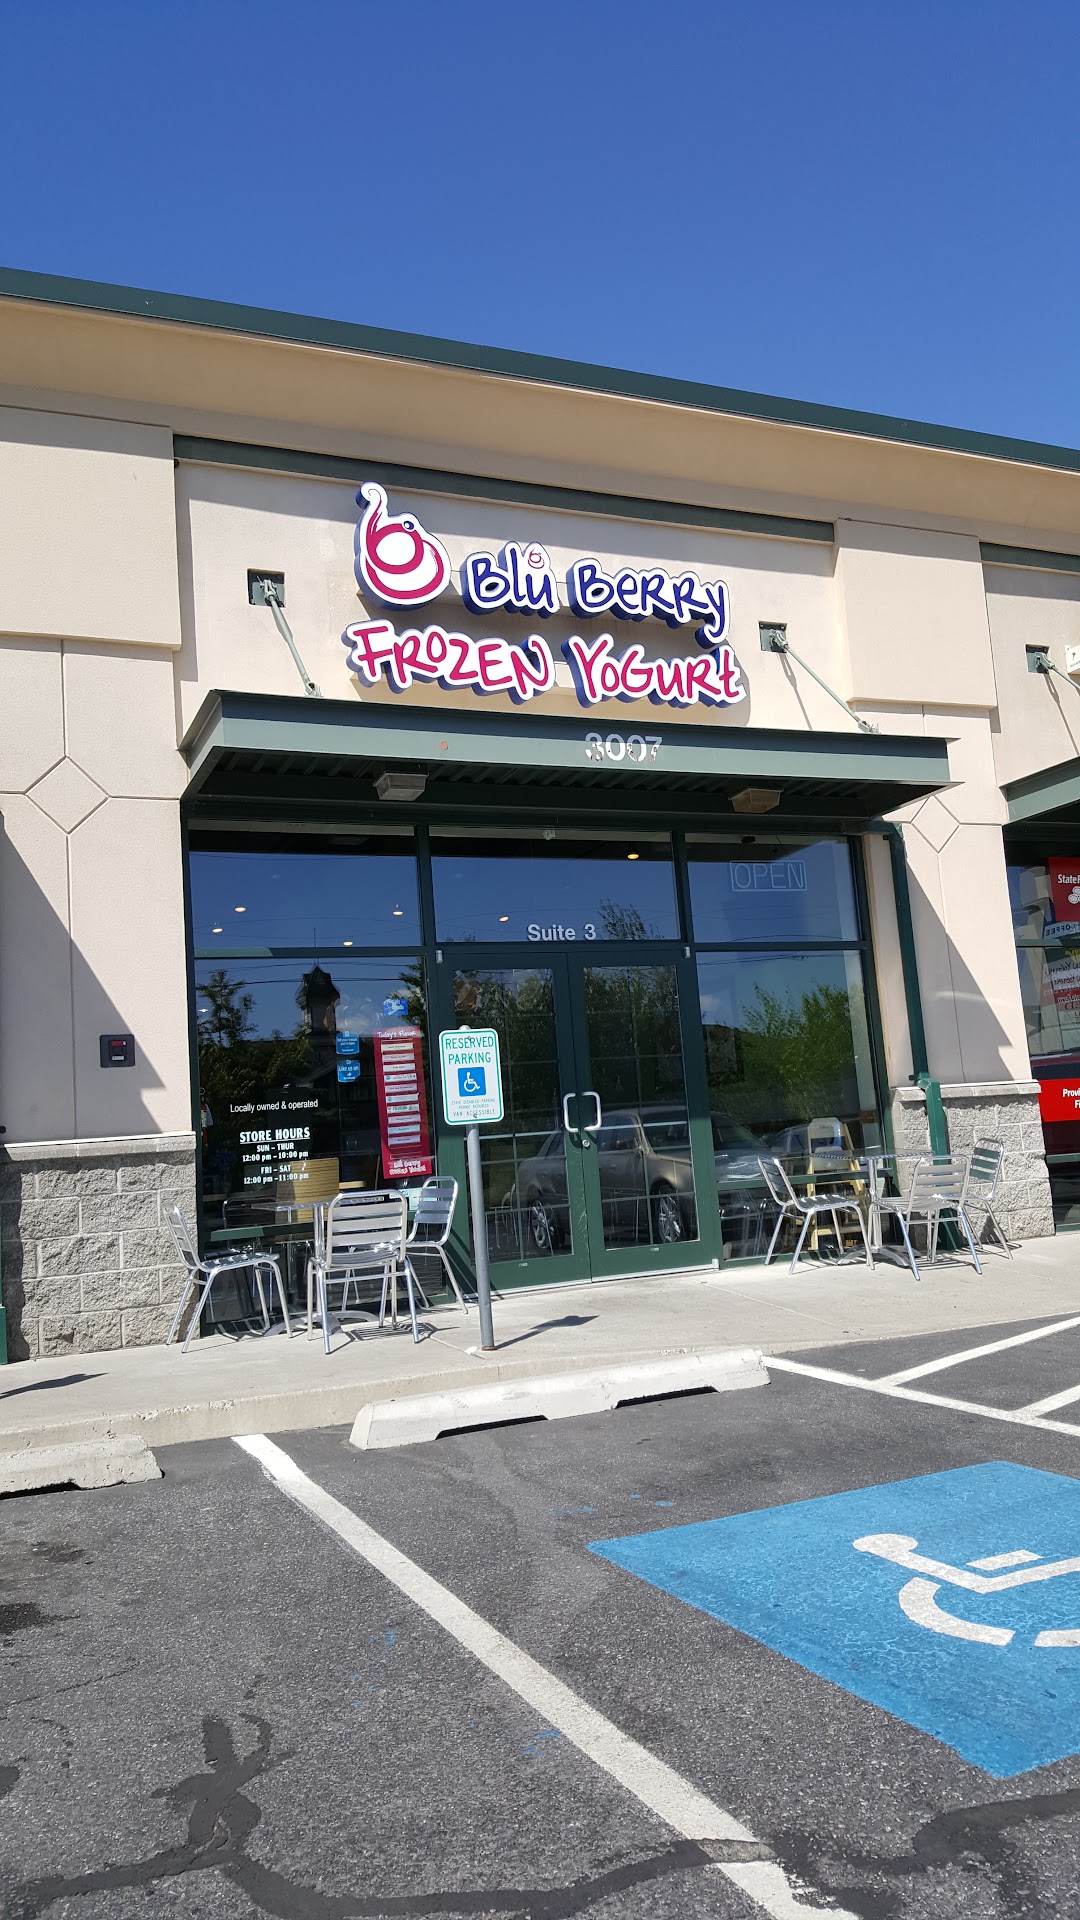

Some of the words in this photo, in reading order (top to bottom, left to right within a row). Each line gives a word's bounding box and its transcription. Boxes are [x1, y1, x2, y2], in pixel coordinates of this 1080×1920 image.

[584, 732, 663, 762] 3007
[733, 862, 805, 889] OPEN
[527, 923, 576, 942] Suite
[584, 923, 597, 941] 3
[445, 1036, 494, 1049] RESERVED
[448, 1052, 491, 1065] PARKING
[230, 1102, 255, 1113] Locally
[256, 1101, 279, 1111] owned
[281, 1100, 287, 1110] &
[288, 1099, 318, 1110] operated
[239, 1130, 272, 1142] STORE
[275, 1127, 310, 1139] HOURS
[256, 1144, 270, 1152] SUN
[277, 1142, 294, 1150] THUR
[242, 1154, 260, 1162] 12:00
[278, 1151, 298, 1160] 10:00
[298, 1151, 308, 1159] pm
[260, 1166, 272, 1174] FRI
[279, 1164, 291, 1172] SAT
[244, 1176, 262, 1184] 12:00
[278, 1173, 298, 1182] 11:00
